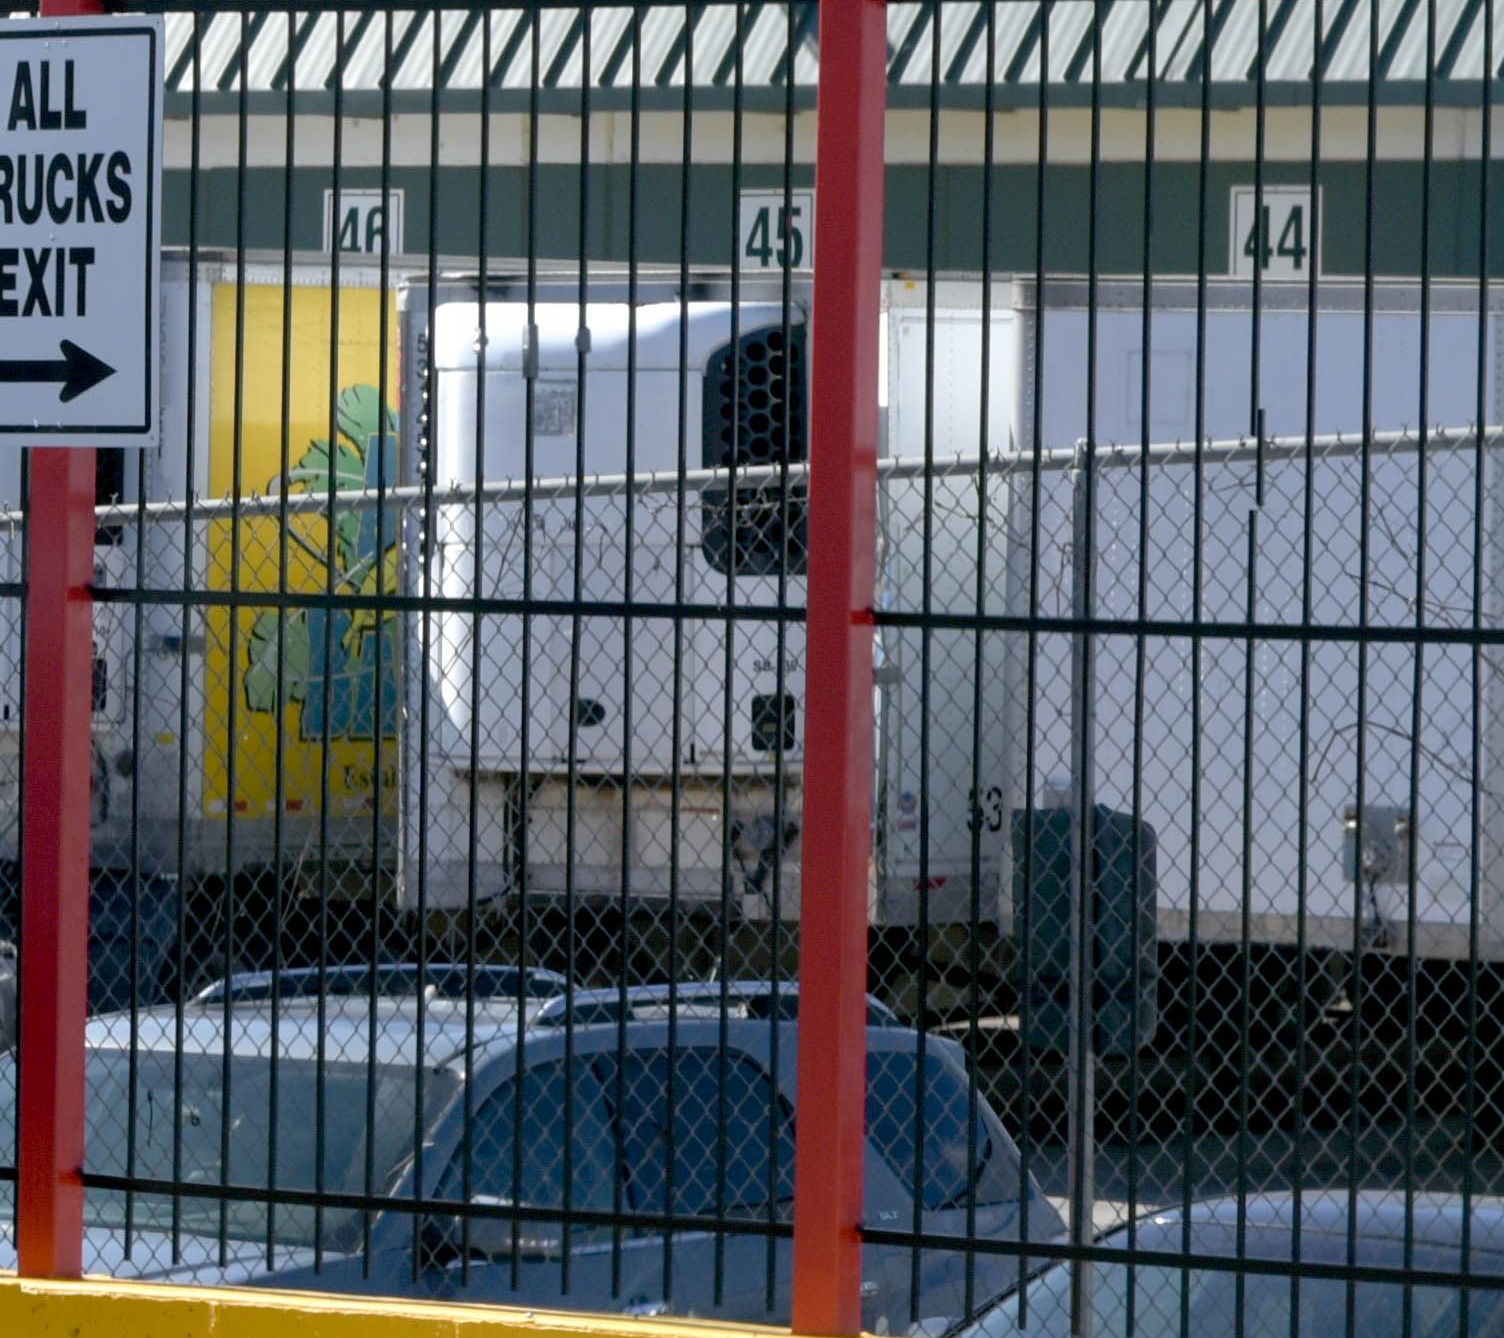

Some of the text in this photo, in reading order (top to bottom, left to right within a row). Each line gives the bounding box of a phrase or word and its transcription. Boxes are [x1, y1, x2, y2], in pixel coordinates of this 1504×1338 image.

[7, 59, 87, 131] ALL
[745, 206, 803, 268] 45
[1243, 204, 1307, 271] 44
